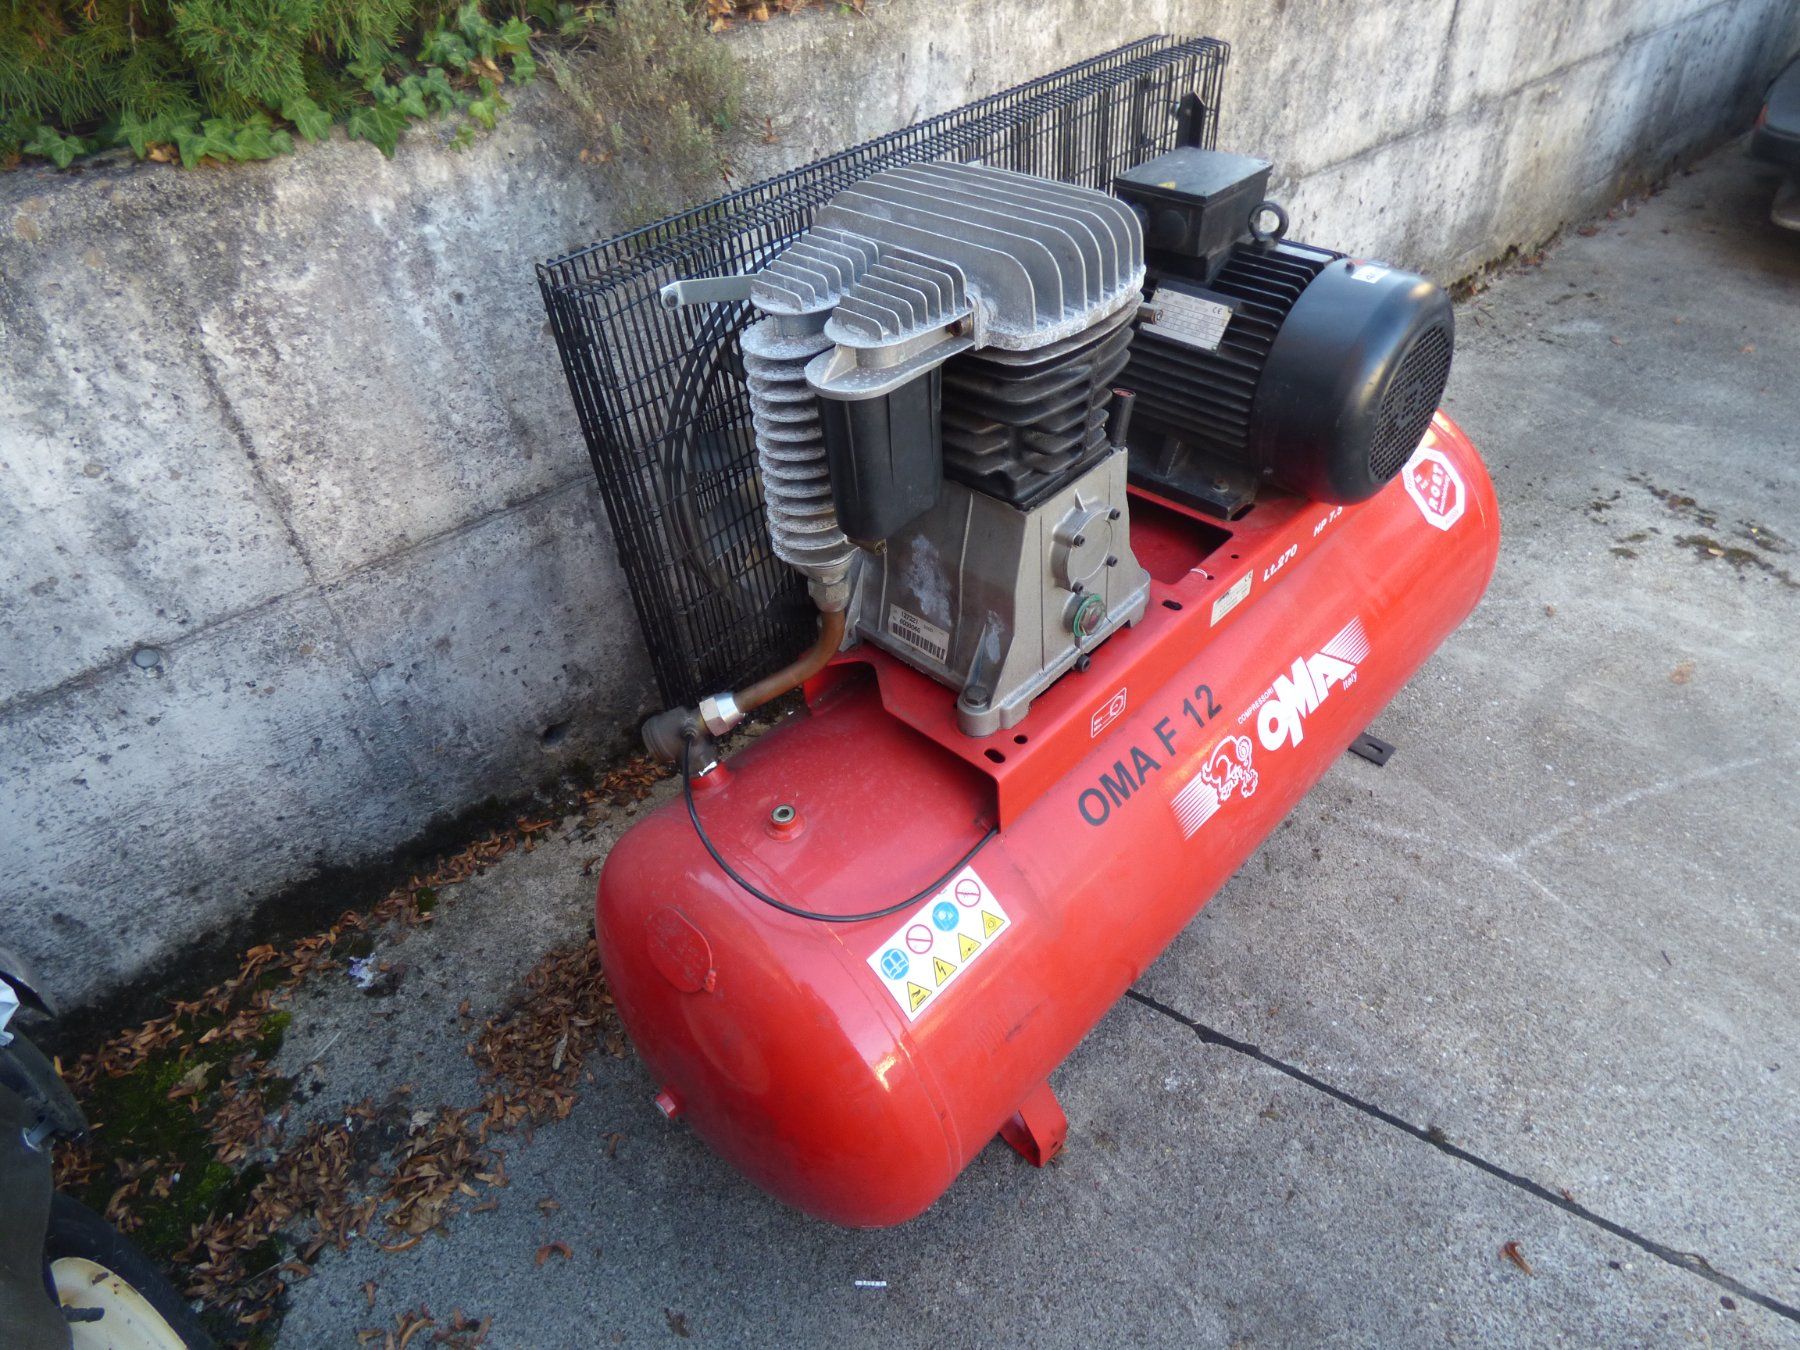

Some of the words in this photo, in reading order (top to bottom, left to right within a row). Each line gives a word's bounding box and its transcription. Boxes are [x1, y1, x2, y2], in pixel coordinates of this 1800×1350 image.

[1313, 518, 1327, 538] HP
[1342, 670, 1358, 691] Italy
[1237, 686, 1275, 725] COMPRESSORI
[1257, 652, 1356, 751] OMA
[1078, 746, 1162, 827] OMA
[1153, 716, 1177, 757] F
[1183, 684, 1223, 728] 12
